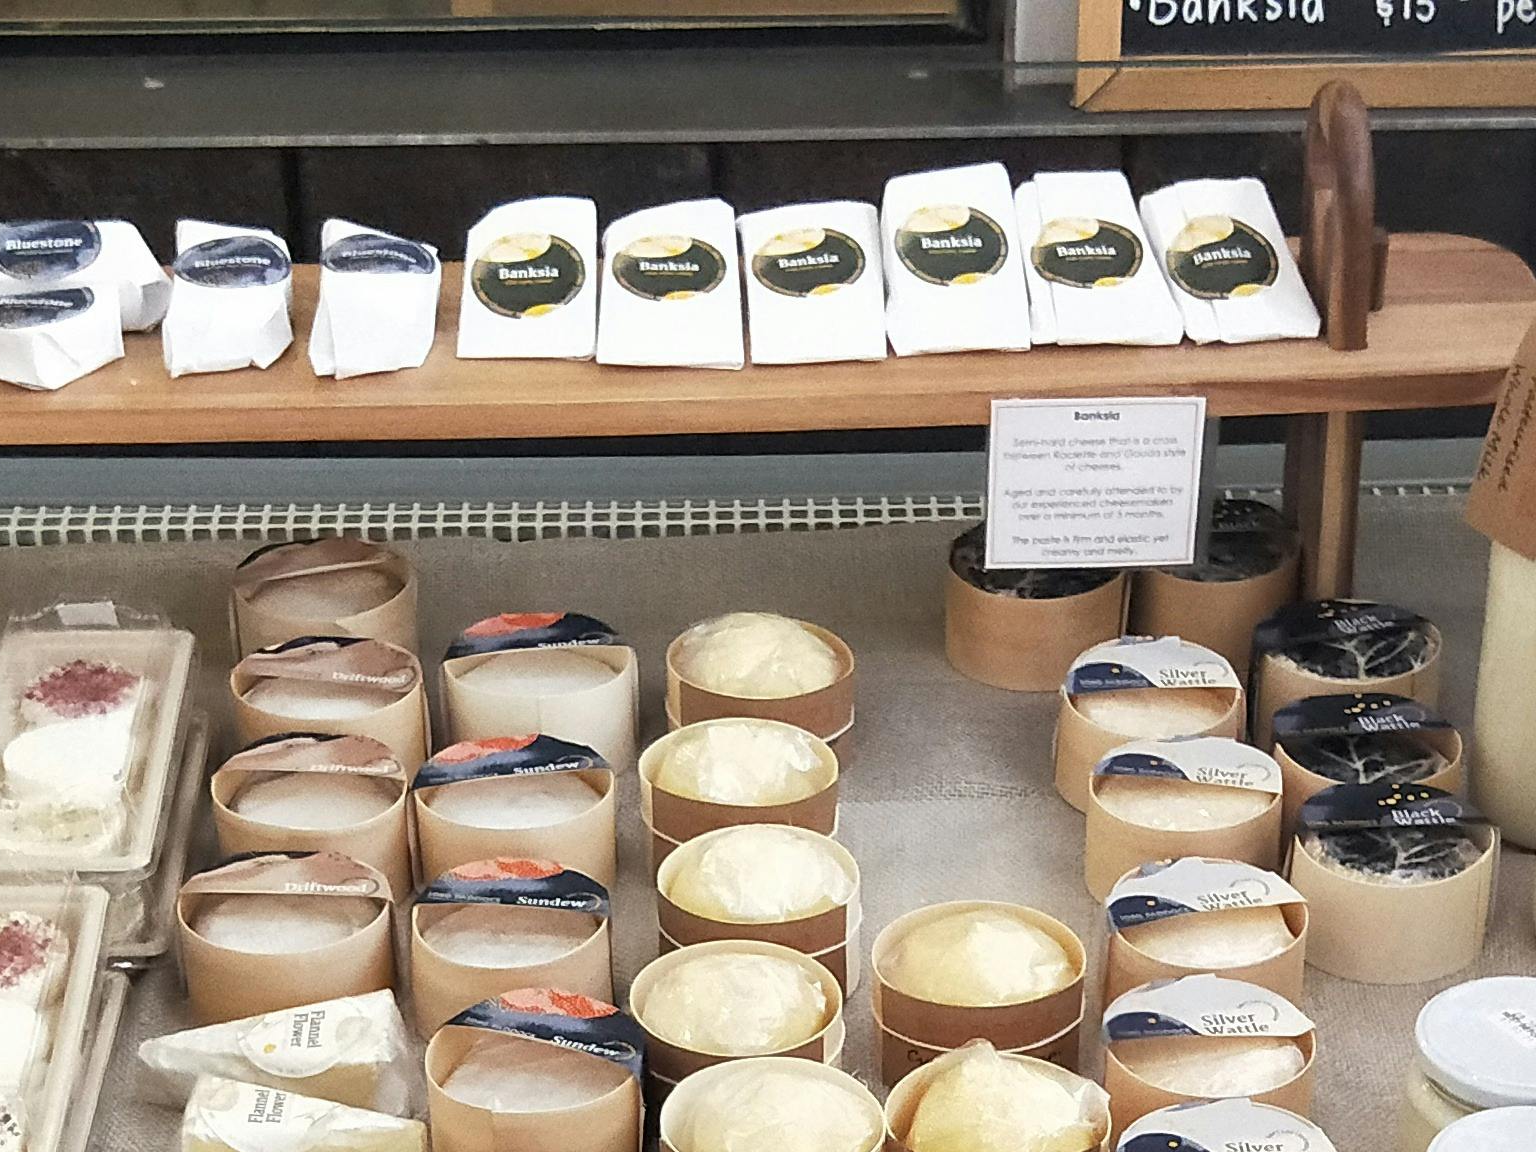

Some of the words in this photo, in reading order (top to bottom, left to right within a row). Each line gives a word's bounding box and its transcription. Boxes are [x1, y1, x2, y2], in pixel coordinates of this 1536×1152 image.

[5, 236, 84, 251] Bluestone
[921, 235, 983, 250] Banksia
[1055, 244, 1118, 257] Banksia
[1192, 246, 1252, 266] Banksia
[194, 255, 272, 268] Bluestone
[638, 260, 701, 273] Banksia
[777, 252, 841, 270] Banksia
[498, 266, 560, 280] Banksia
[1073, 410, 1120, 421] Banksia
[1333, 615, 1375, 629] Black
[1341, 620, 1395, 635] Wattle
[537, 638, 601, 649] Sundew
[332, 671, 408, 685] Driftwood
[1158, 666, 1208, 680] Silver
[1159, 676, 1217, 688] Wattle
[1357, 713, 1406, 727] Black
[1364, 719, 1421, 733] Wattle
[512, 760, 580, 776] Sundew
[1195, 766, 1249, 780] Silver
[1195, 776, 1255, 787] Wattle
[1391, 807, 1441, 821] Black
[1394, 815, 1457, 827] Wattle
[284, 881, 368, 894] Driftwood
[516, 895, 587, 908] Sundew
[1196, 889, 1249, 905] Silver
[1201, 896, 1264, 911] Wattle
[1200, 1012, 1256, 1025] Silver
[290, 1013, 309, 1048] Flower
[307, 1010, 326, 1048] Flannel
[1203, 1022, 1270, 1035] Wattle
[549, 1034, 620, 1057] Sundew
[247, 1089, 271, 1124] Flannel
[265, 1092, 287, 1124] Flower
